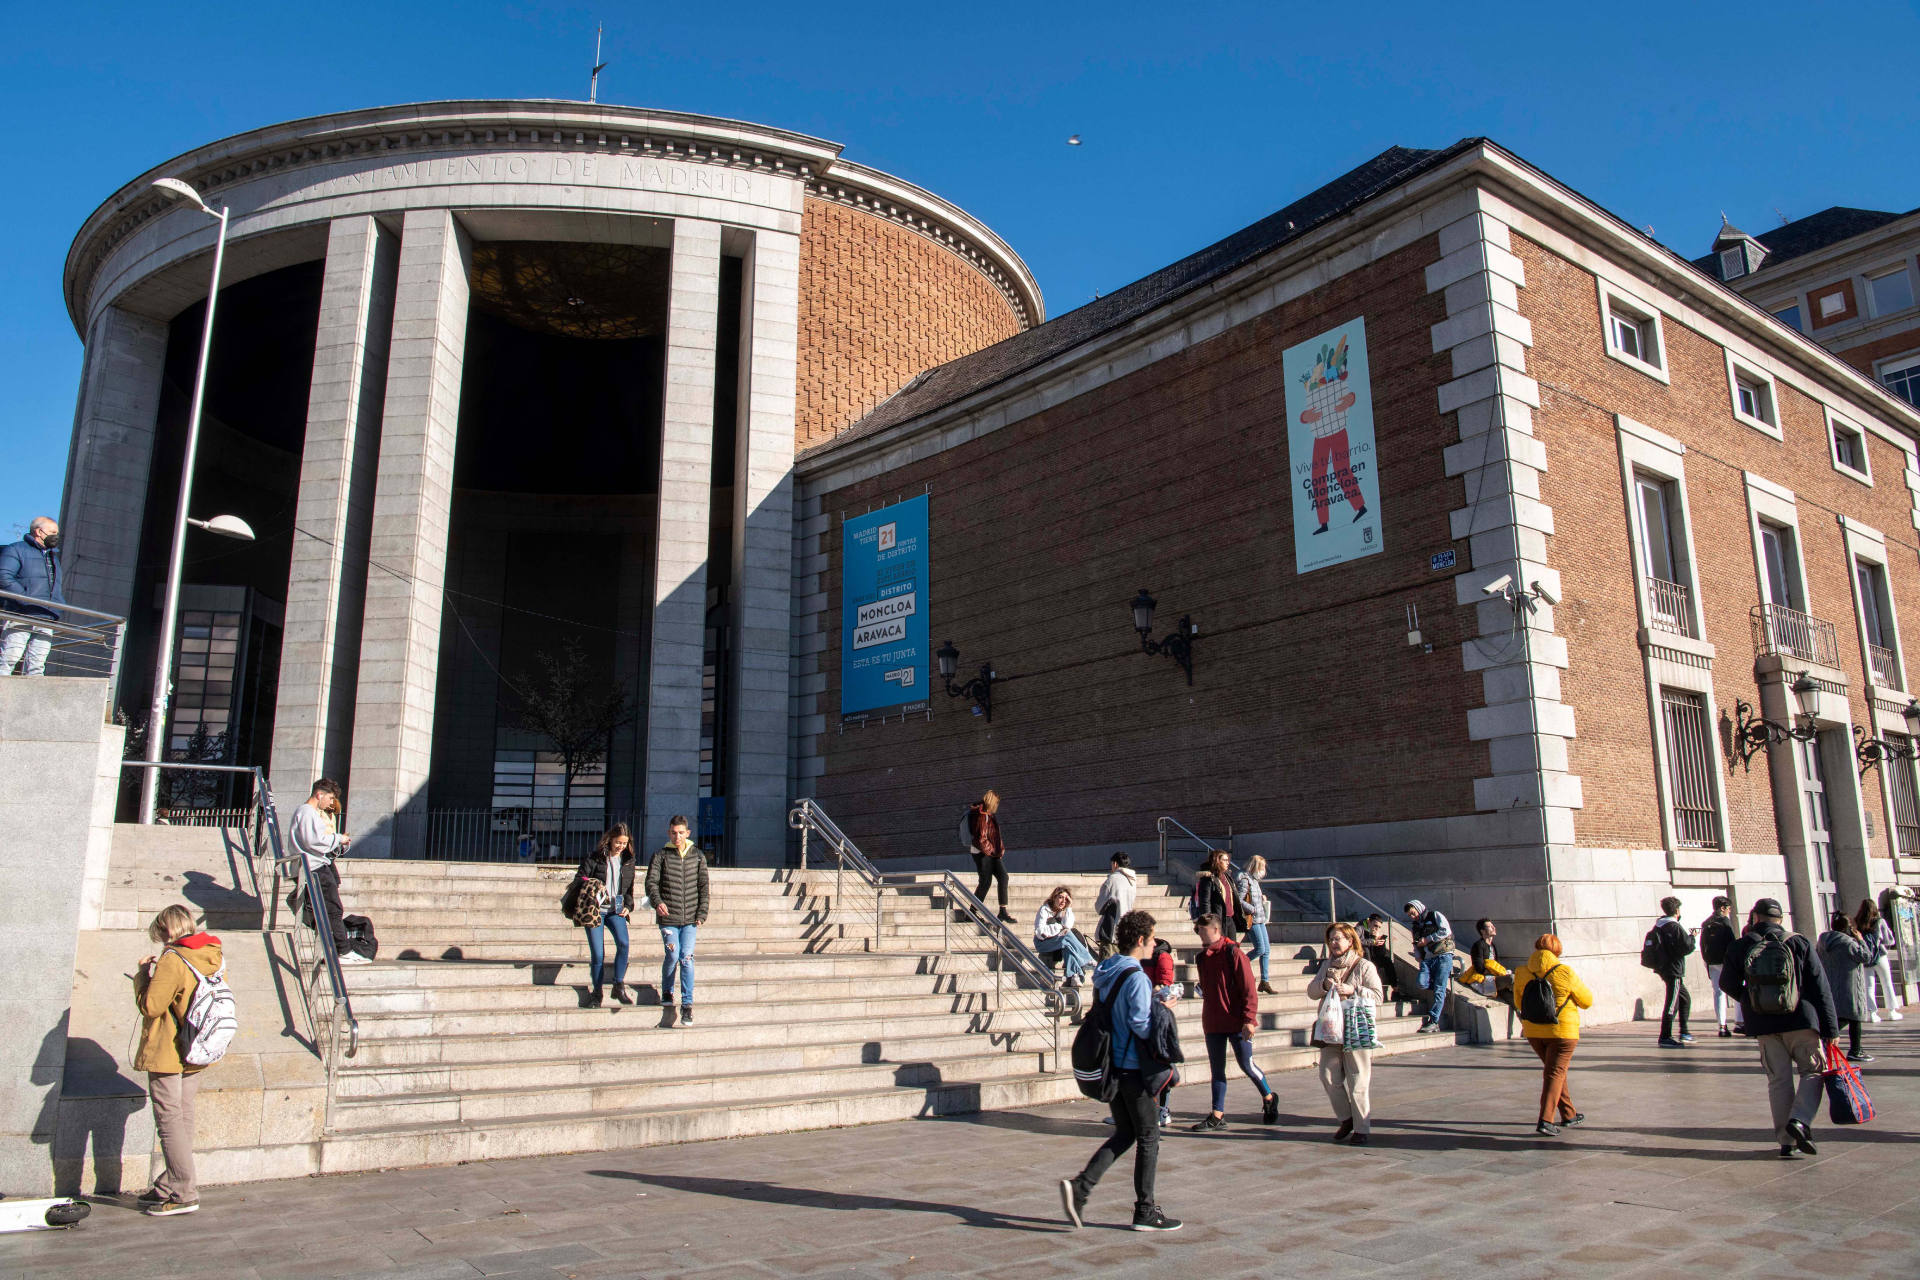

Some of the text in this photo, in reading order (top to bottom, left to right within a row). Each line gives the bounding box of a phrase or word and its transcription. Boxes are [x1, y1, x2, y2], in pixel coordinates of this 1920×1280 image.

[555, 157, 592, 177] DE
[622, 160, 750, 194] MADRID
[1295, 442, 1371, 475] Vive tu barrio.
[1303, 461, 1366, 489] Compra en
[1307, 474, 1363, 500] Moncloa-
[1310, 488, 1361, 511] Aravaca.
[853, 526, 877, 540] MADRID
[860, 534, 877, 545] TIENE
[881, 529, 893, 545] 21
[897, 537, 917, 549] JUNTAS
[1360, 543, 1378, 552] MADRID
[877, 544, 917, 562] DE DISTRITO
[885, 563, 905, 574] VIVES
[907, 559, 916, 568] EN
[1432, 559, 1454, 570] MONCLOA
[877, 568, 916, 584] ESTE BARRIO
[881, 582, 912, 597] DISTRITO
[860, 600, 912, 622] MONCLOA
[856, 624, 902, 644] ARAVACA
[853, 647, 916, 669] ESTA ES TU JUNTA
[886, 671, 900, 679] MADRID
[903, 669, 913, 684] 21
[907, 702, 926, 711] MADRID
